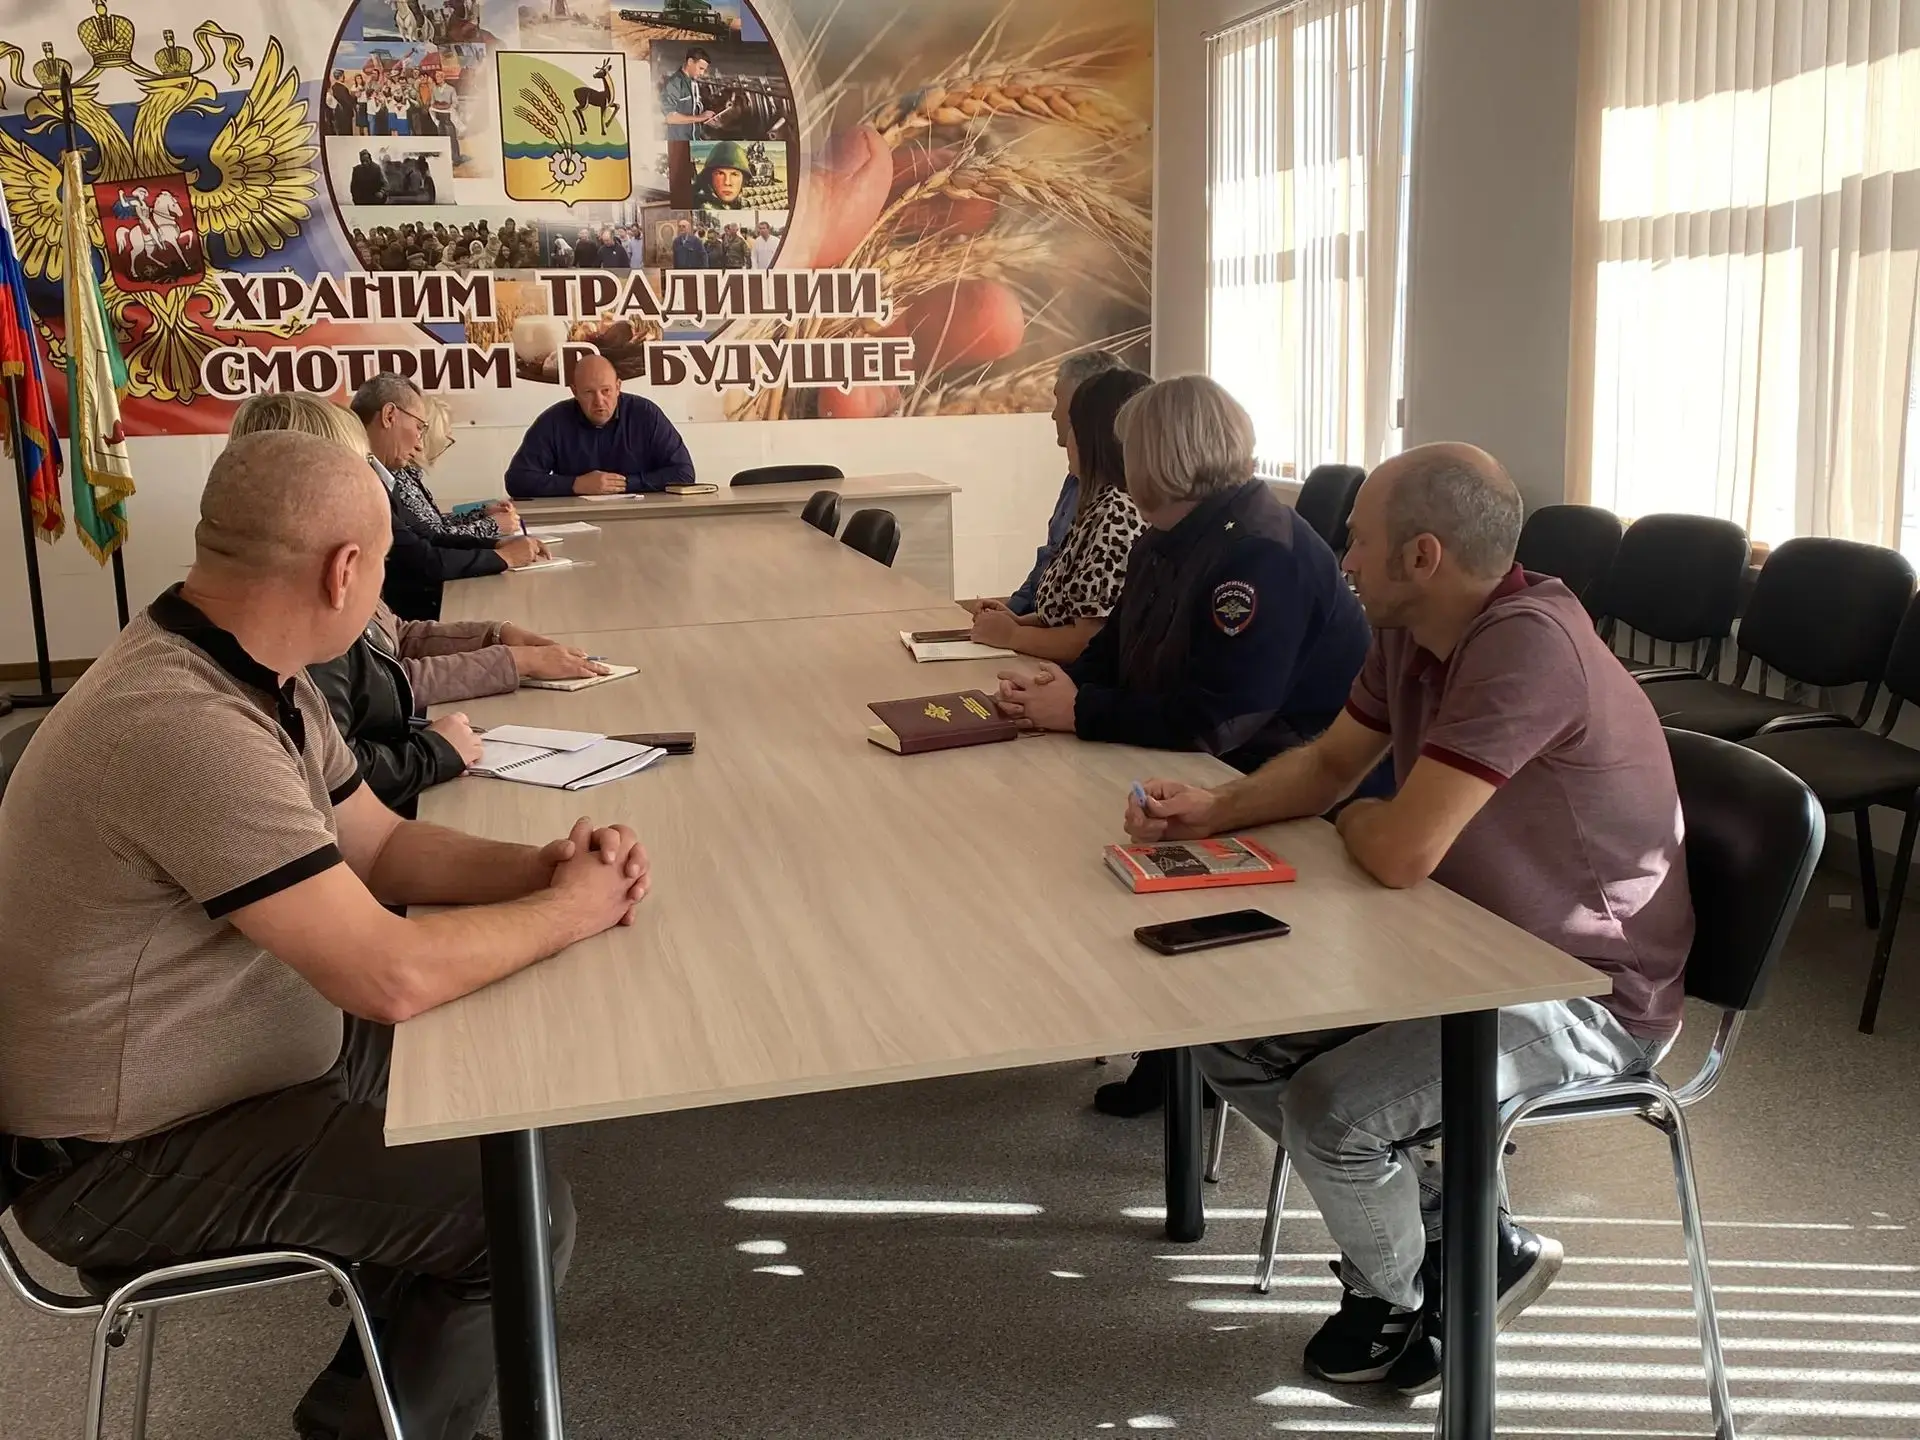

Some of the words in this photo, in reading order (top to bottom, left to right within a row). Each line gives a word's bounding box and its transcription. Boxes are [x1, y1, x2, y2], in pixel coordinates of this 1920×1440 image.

[219, 273, 495, 321] ХРАНИМ
[538, 271, 892, 324] ТРАДИЦИИ,
[204, 345, 514, 396] СМОТРИМ
[648, 339, 914, 394] БУДУЩЕЕ
